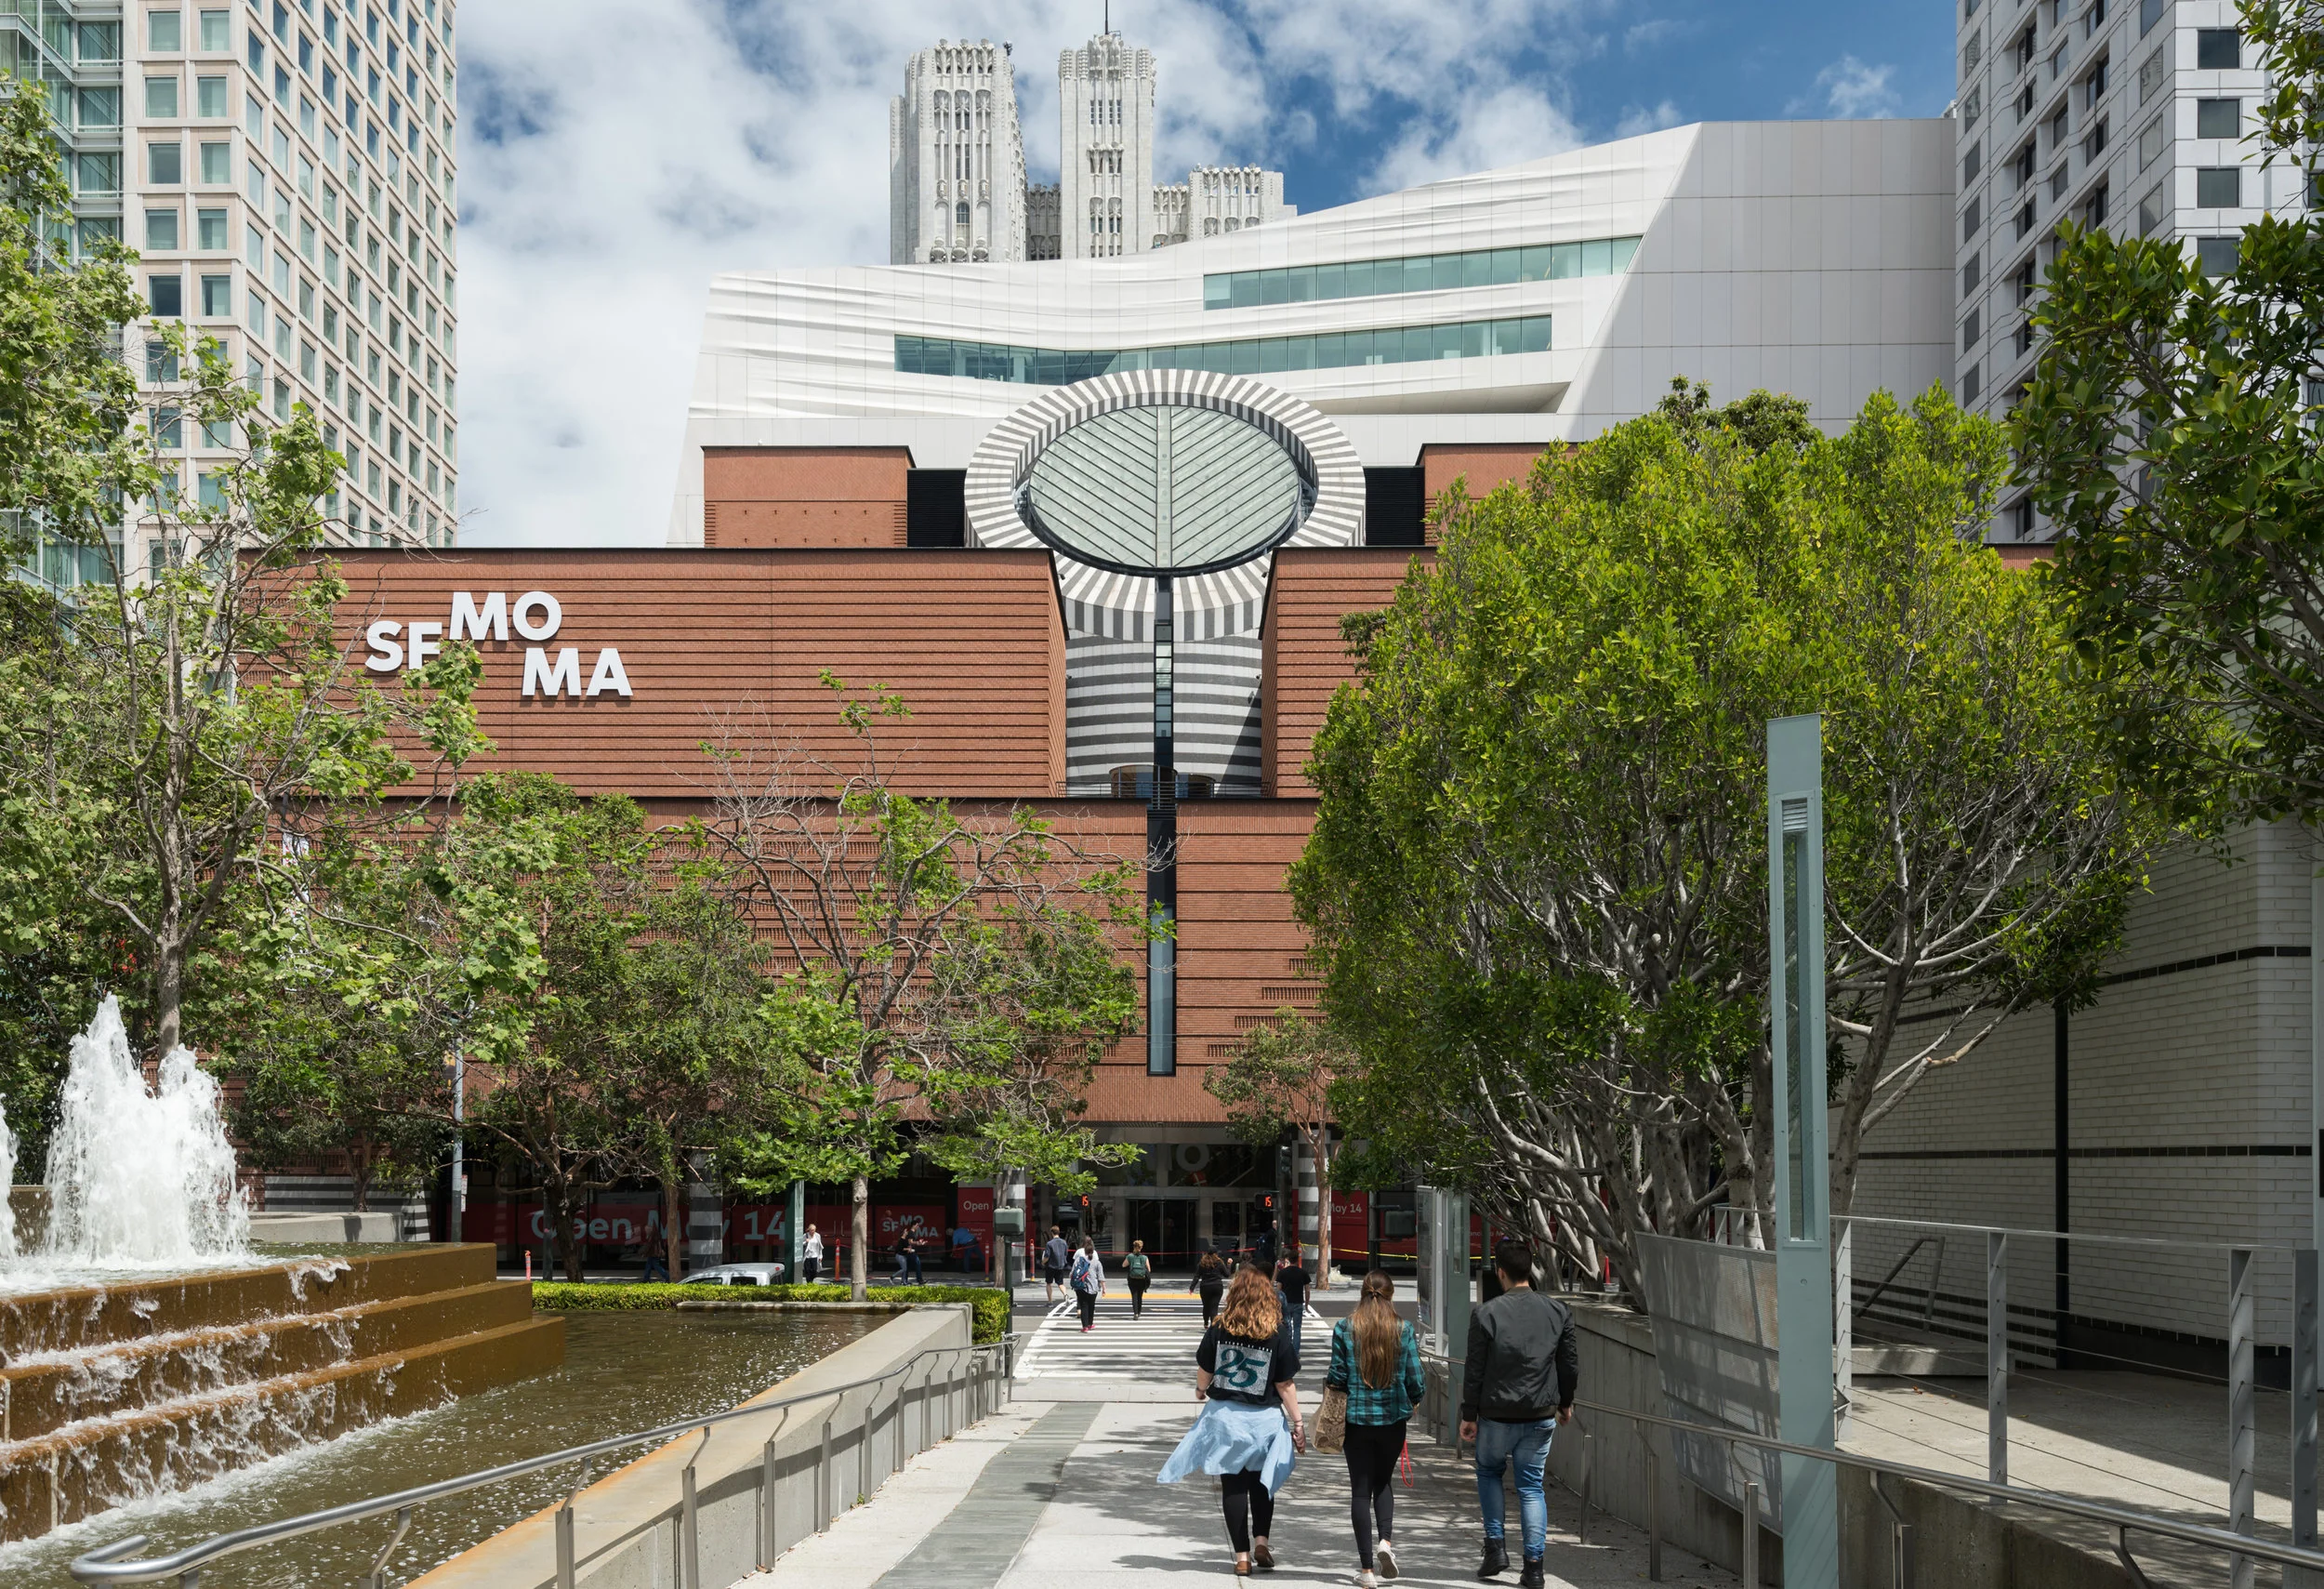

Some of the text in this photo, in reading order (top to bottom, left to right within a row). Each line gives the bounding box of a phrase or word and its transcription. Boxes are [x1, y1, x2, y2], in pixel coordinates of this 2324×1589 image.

[963, 1200, 989, 1212] Open
[1082, 1195, 1089, 1207] 15
[1265, 1196, 1272, 1207] 15
[1350, 1203, 1363, 1213] 14
[744, 1211, 786, 1240] 14
[1215, 1348, 1267, 1387] 25
